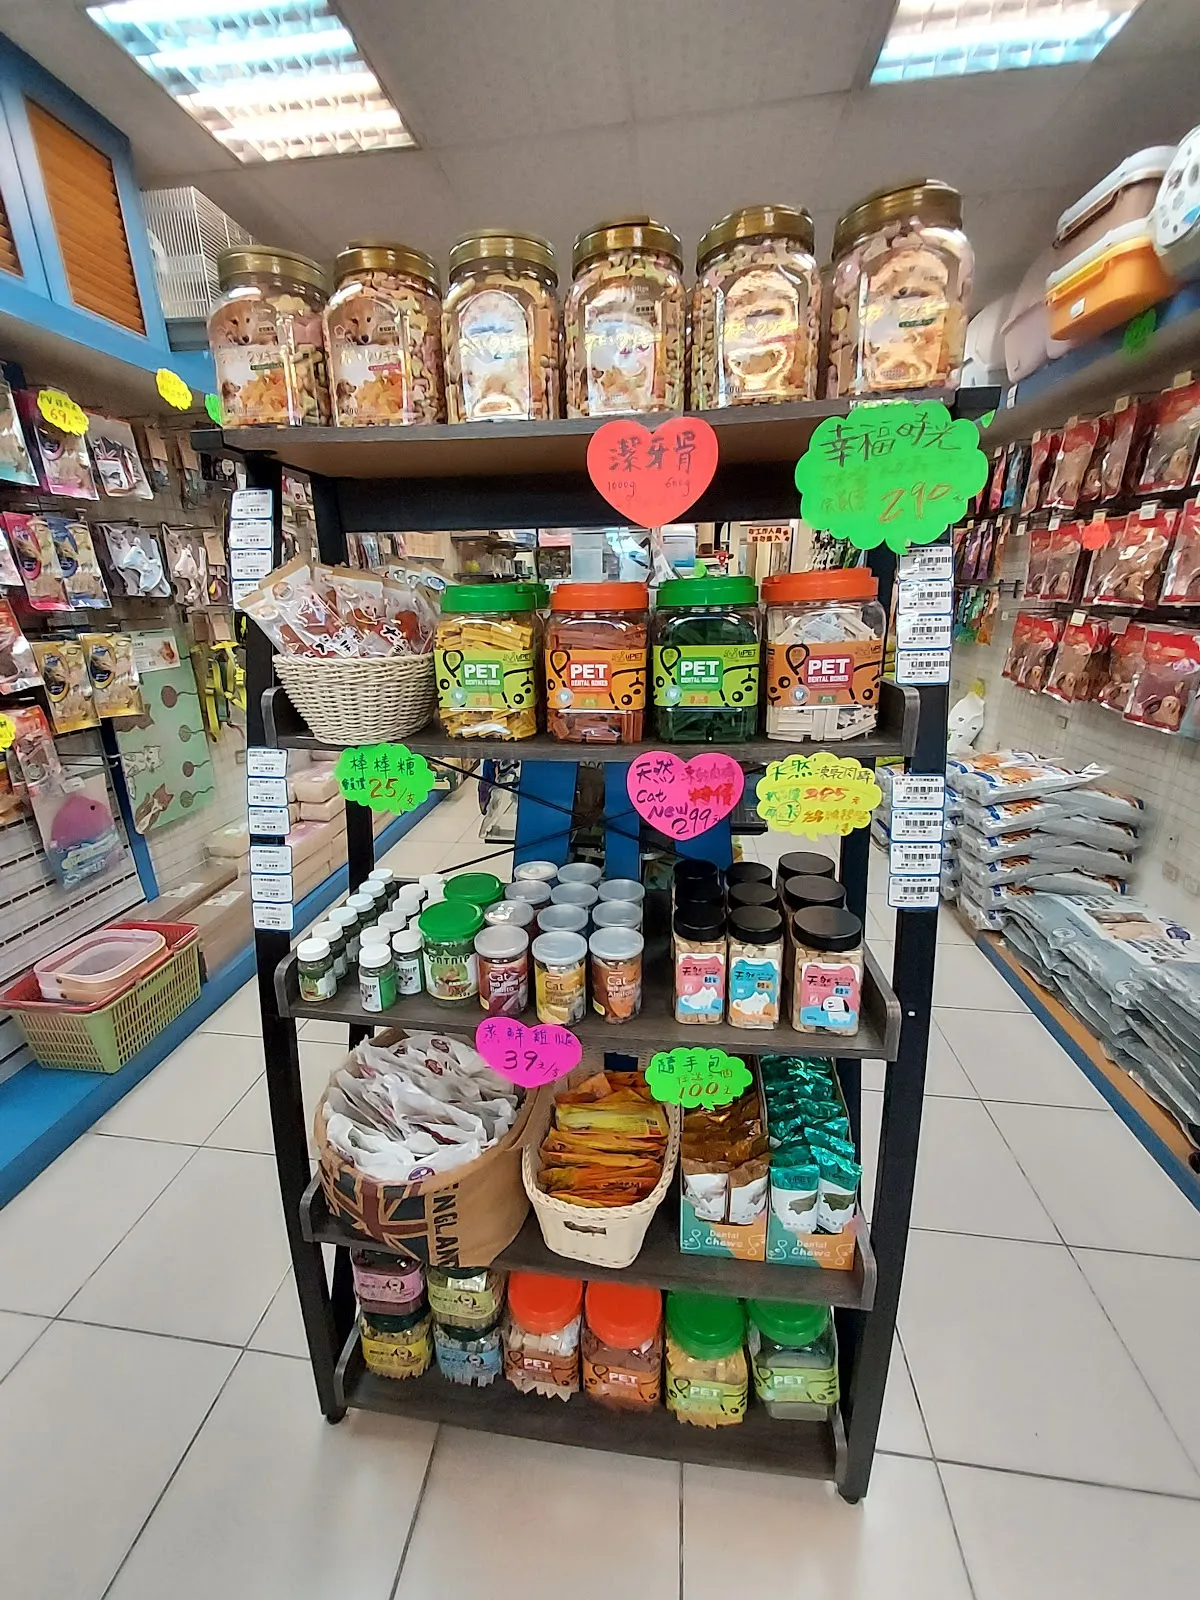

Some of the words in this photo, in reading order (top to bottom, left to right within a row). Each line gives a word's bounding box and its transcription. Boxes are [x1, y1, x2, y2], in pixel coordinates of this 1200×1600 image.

[820, 412, 962, 467] 幸福時光
[607, 481, 637, 499] 1000g
[463, 663, 500, 679] PET
[570, 663, 608, 679] PET
[680, 660, 720, 676] PET
[807, 658, 851, 675] PET
[636, 788, 668, 804] Cat
[488, 971, 509, 982] Cat
[606, 975, 627, 986] Cat
[544, 980, 565, 991] Cat
[709, 1229, 740, 1239] Dental
[796, 1239, 828, 1249] Dental
[523, 1357, 552, 1369] PET
[608, 1372, 638, 1384] PET
[773, 1375, 805, 1386] PET
[689, 1385, 721, 1397] PET
